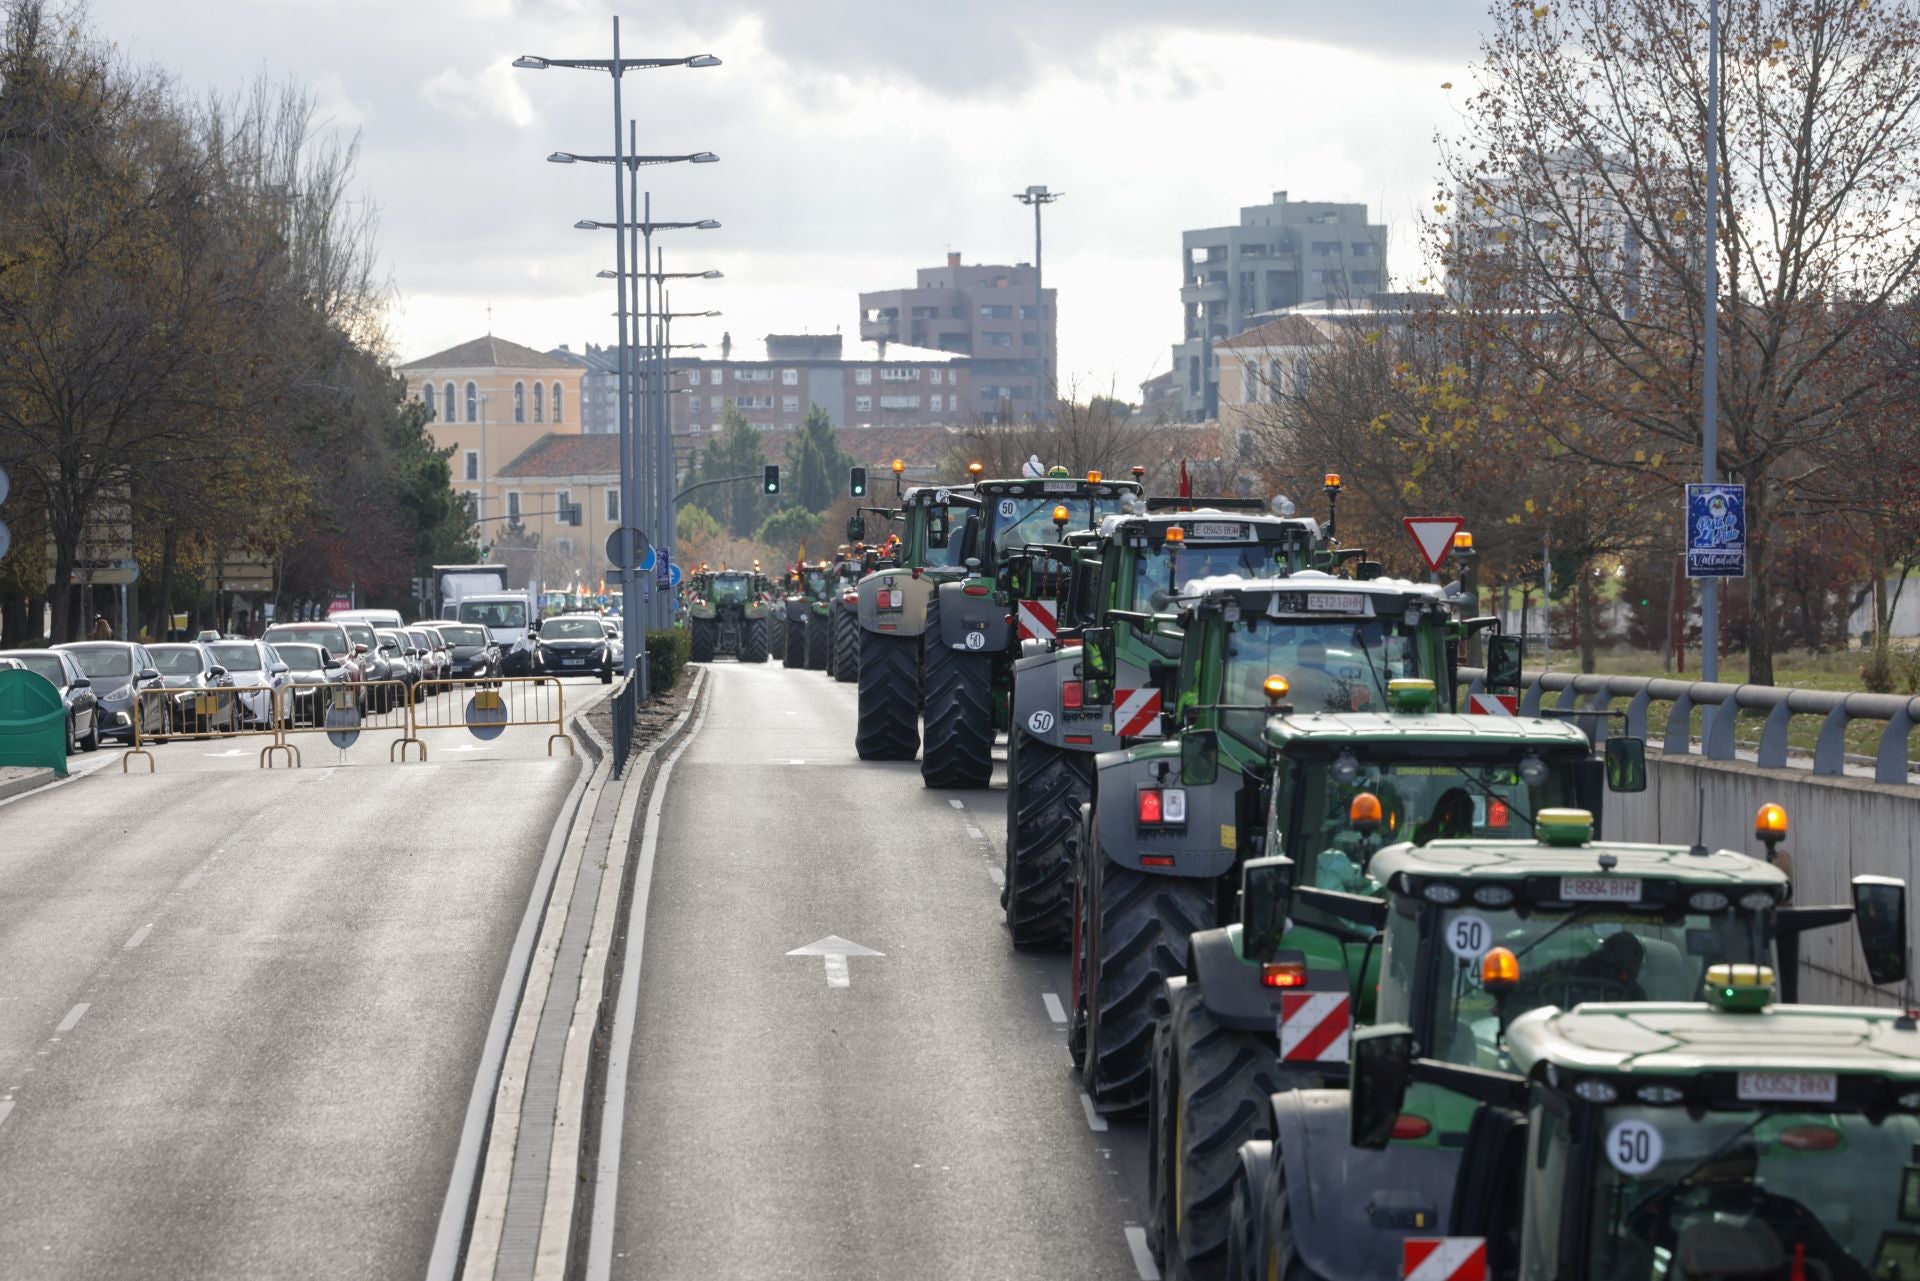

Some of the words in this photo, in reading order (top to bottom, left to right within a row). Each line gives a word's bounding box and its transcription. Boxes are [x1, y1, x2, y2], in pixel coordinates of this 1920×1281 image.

[1002, 502, 1014, 515] 50
[1691, 554, 1742, 567] Valladolid
[970, 633, 981, 647] 50
[1033, 713, 1051, 730] 50
[1456, 921, 1482, 950] 50
[1619, 1130, 1649, 1164] 50
